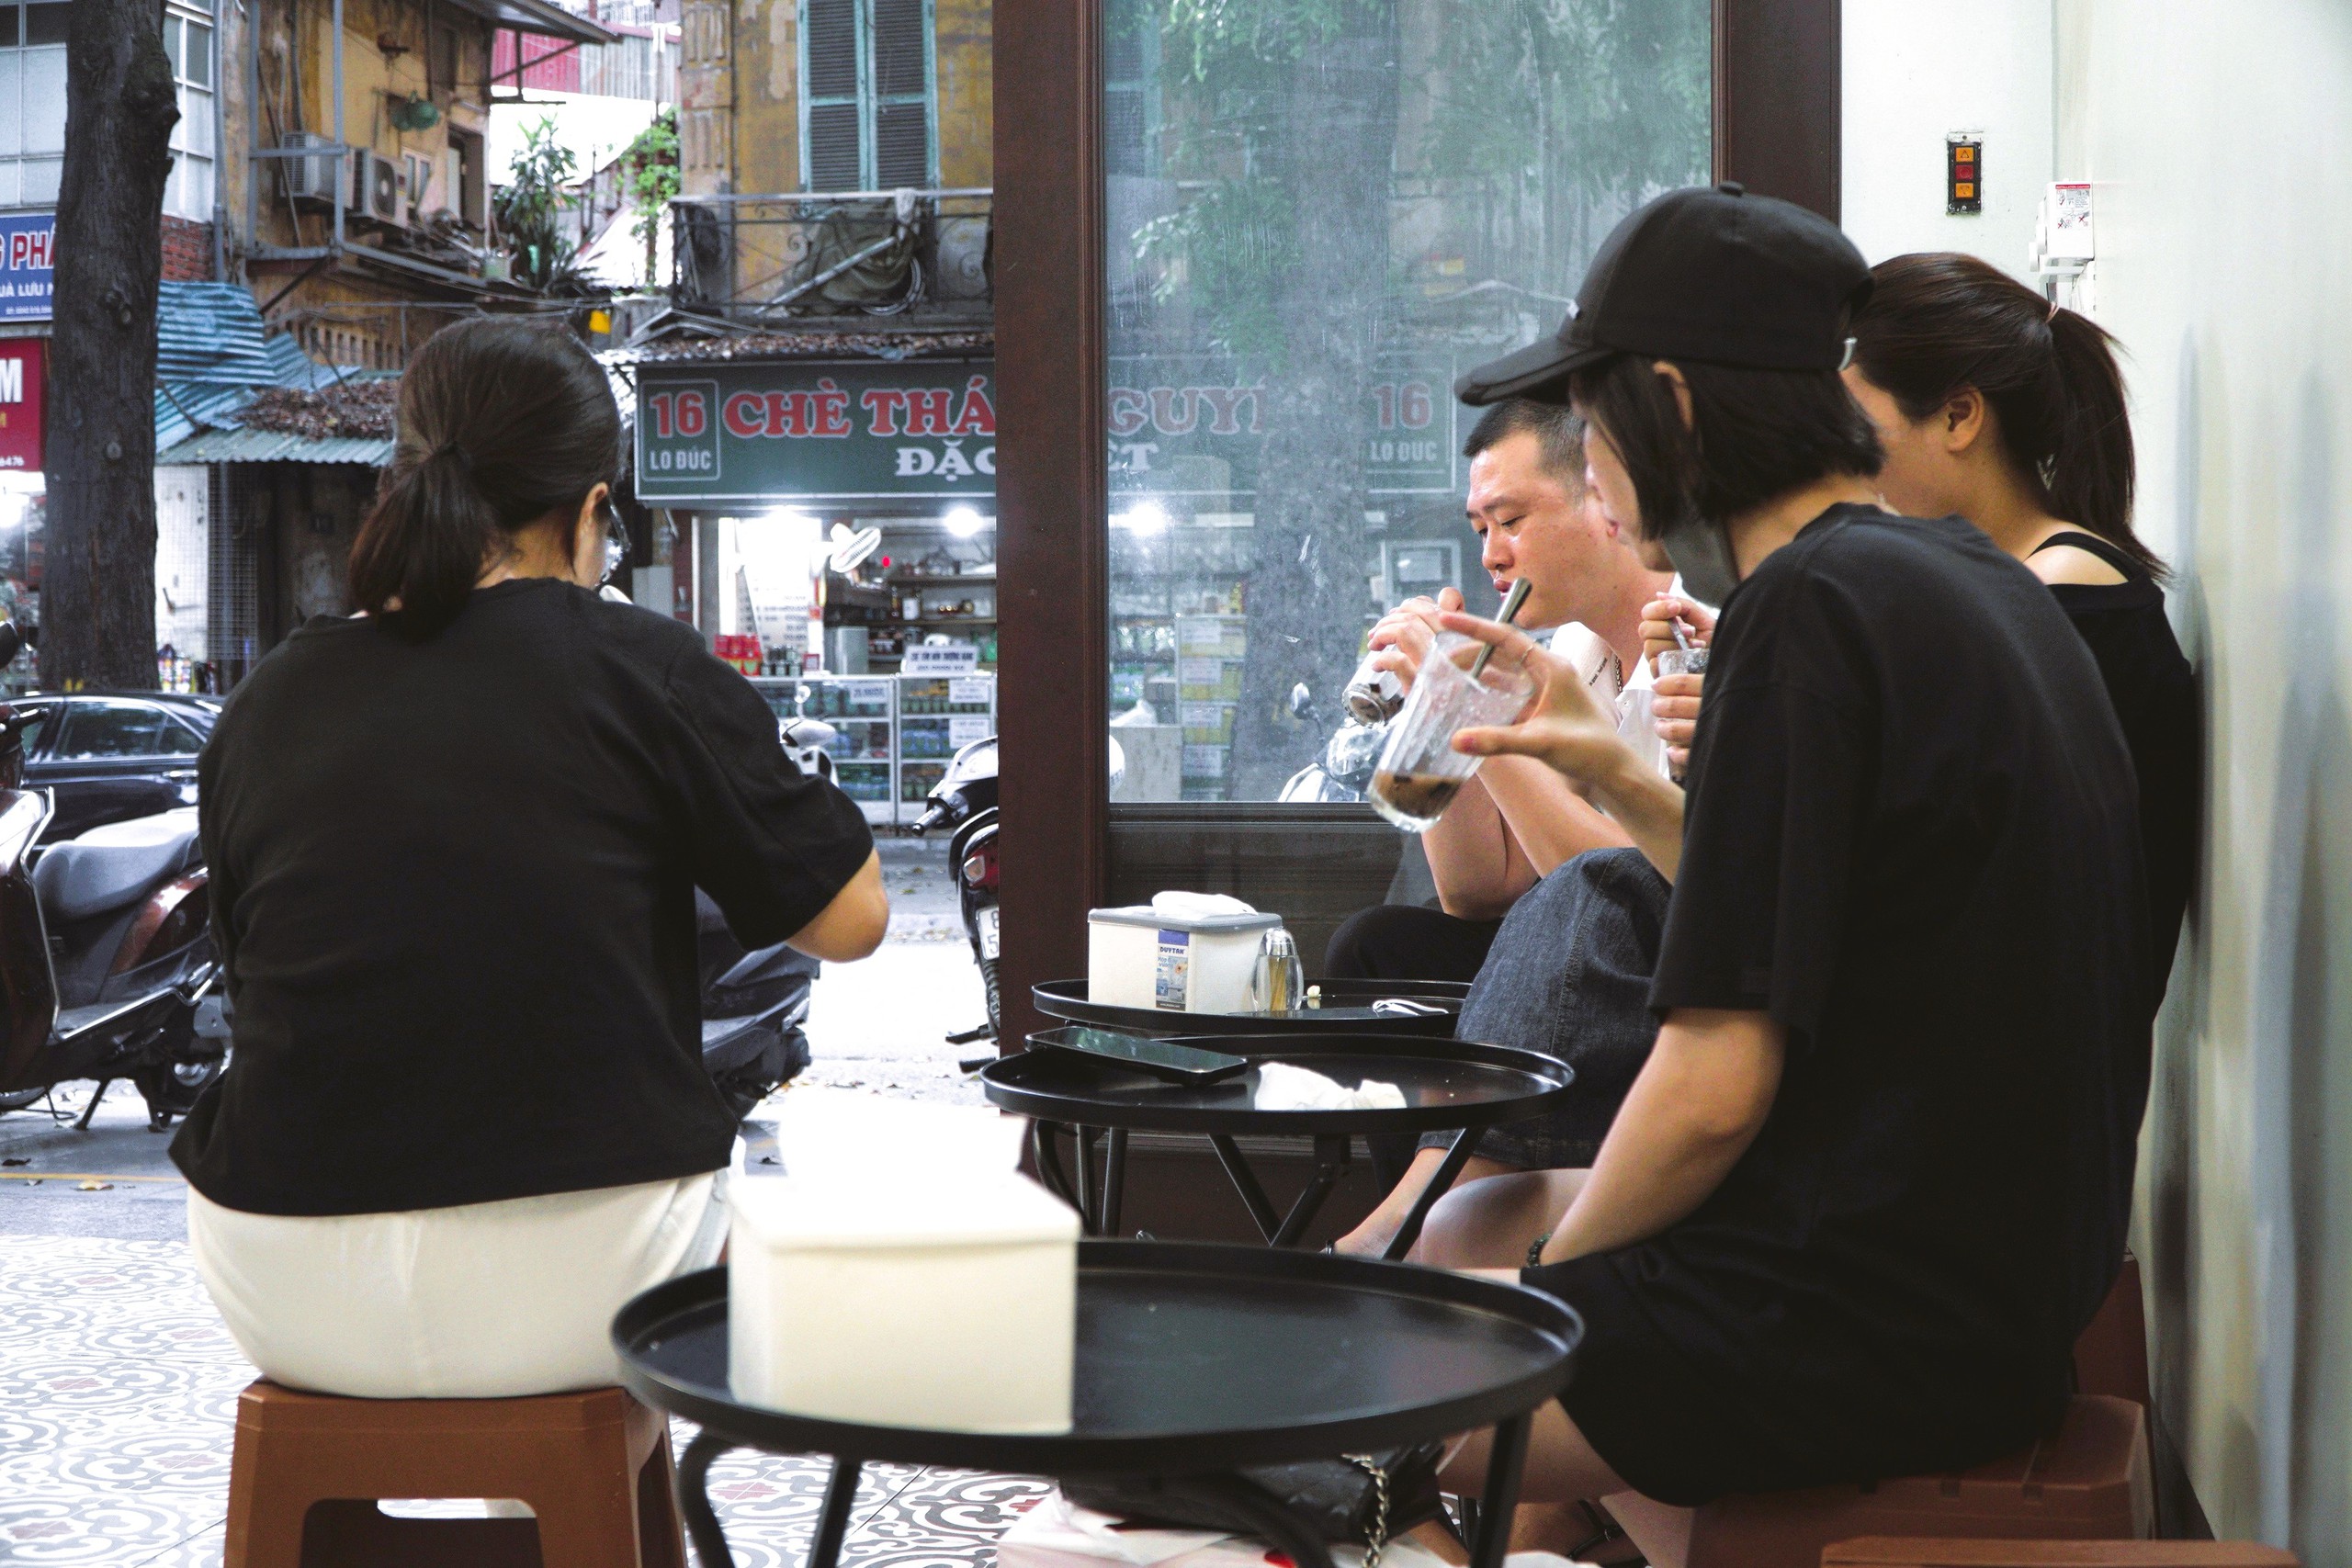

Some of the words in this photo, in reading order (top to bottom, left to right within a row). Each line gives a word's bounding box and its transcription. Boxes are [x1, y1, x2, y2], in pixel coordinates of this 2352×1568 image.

[649, 389, 707, 439] 16
[722, 378, 853, 439] CHÈ
[1371, 381, 1433, 431] 16
